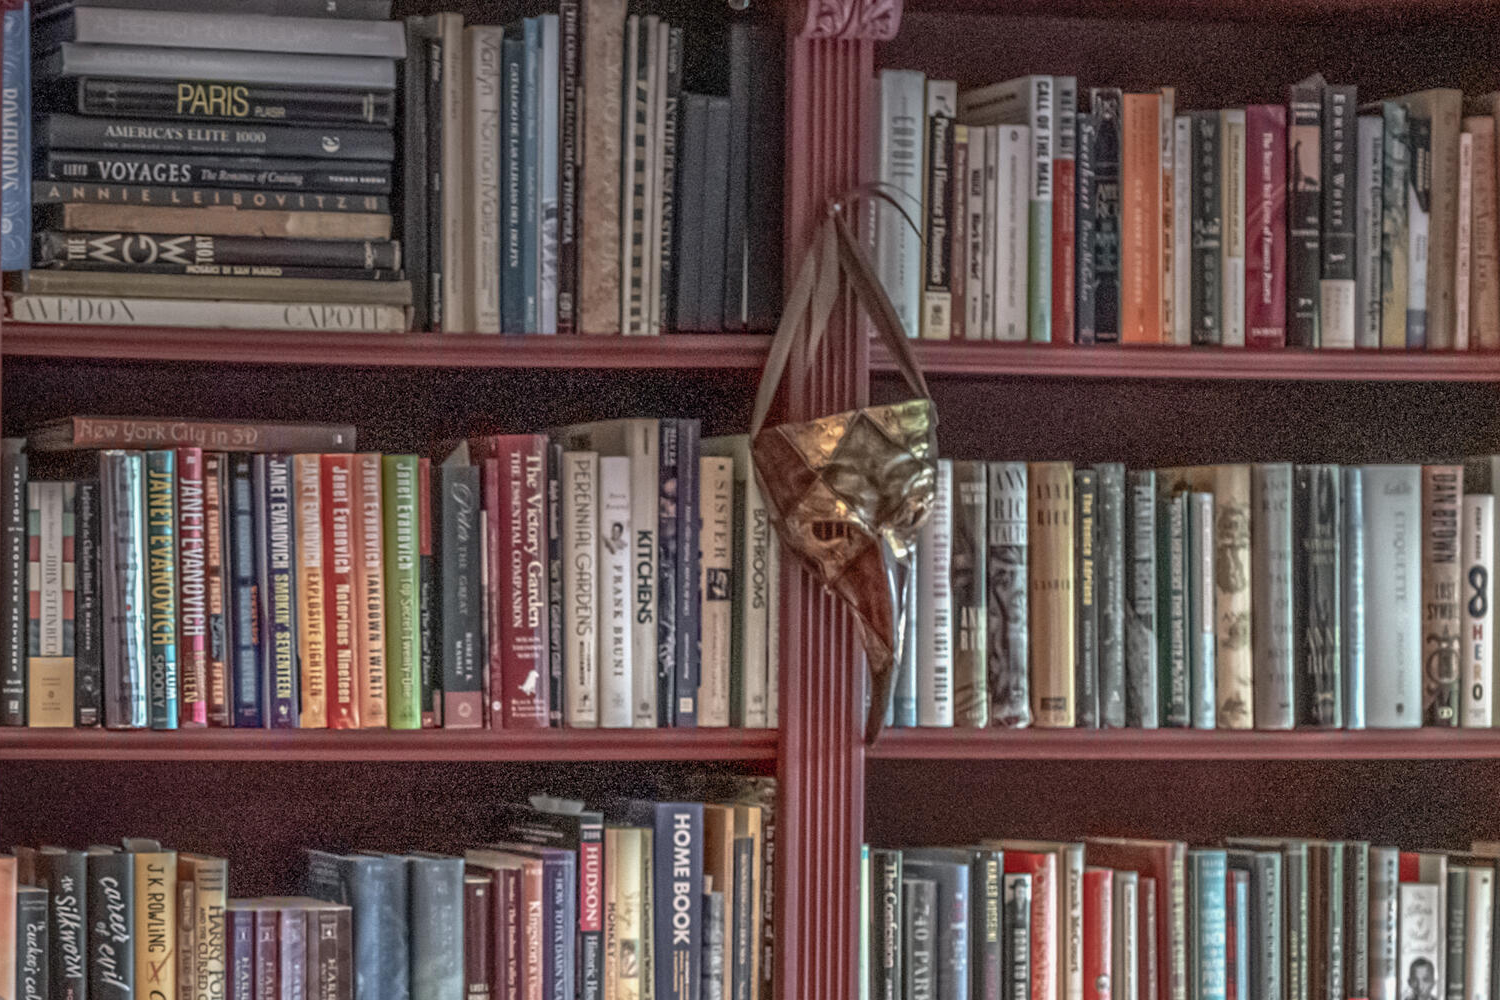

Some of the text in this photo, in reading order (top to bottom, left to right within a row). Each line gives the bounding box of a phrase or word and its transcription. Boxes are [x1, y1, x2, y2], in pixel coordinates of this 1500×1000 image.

[104, 124, 266, 144] AMERICA'S ELITE 1000
[177, 83, 249, 117] PARIS
[475, 31, 499, 243] Marilyn Norman Mailer
[1036, 80, 1050, 198] CALL OF THE MALL
[49, 187, 348, 210] ANNIE LEIBOVITZ
[97, 160, 192, 183] VOYAGES
[1332, 93, 1346, 227] EDMUND WHITE
[79, 424, 118, 441] New
[124, 423, 166, 444] York
[172, 425, 207, 446] City
[511, 451, 524, 630] THE ESSENTIAL COMPANION
[524, 450, 546, 629] The Victory Garden
[574, 460, 593, 551] PERENNIAL
[713, 478, 728, 560] SISTER
[1431, 474, 1458, 565] DAN BROWN
[45, 554, 59, 586] JOHN
[149, 469, 176, 646] JANET EVANOVICH
[180, 477, 206, 637] JANET EVANOVICH
[207, 475, 225, 705] JANET EVANOVICH FINGER FIFTEEN
[270, 460, 292, 698] JANET EVANOVICH SMOKIN' SEVENTEEN
[301, 460, 323, 698] JANET EVANOVICH EXPLOSIVE EIGHTEEN
[331, 465, 353, 704] Janet Evanovich Notorious Nineteen
[363, 460, 383, 699] Janet Evanovich TAKEDOWN TWENTY
[396, 462, 415, 698] Janet Evanovich Top Secret Twenty-One
[452, 482, 480, 616] Peter THE GREAT
[636, 529, 654, 626] KITCHENS
[752, 507, 768, 610] BATHROOMS
[44, 590, 59, 658] STEINBECK
[576, 554, 594, 637] GARDENS
[612, 563, 624, 677] FRANK BRUNI
[152, 653, 167, 708] SPOOKY
[166, 663, 178, 700] PLUM
[674, 814, 692, 880] HOME
[99, 876, 131, 944] career
[207, 904, 224, 962] HARRY
[555, 878, 565, 905] HOW
[555, 908, 565, 924] TO
[674, 882, 691, 945] BOOK
[884, 863, 898, 969] The Confession
[54, 894, 84, 980] Silkworm
[95, 920, 131, 992] of evil
[197, 942, 208, 989] CURSED
[554, 943, 565, 978] DAMN
[587, 935, 600, 980] Historic
